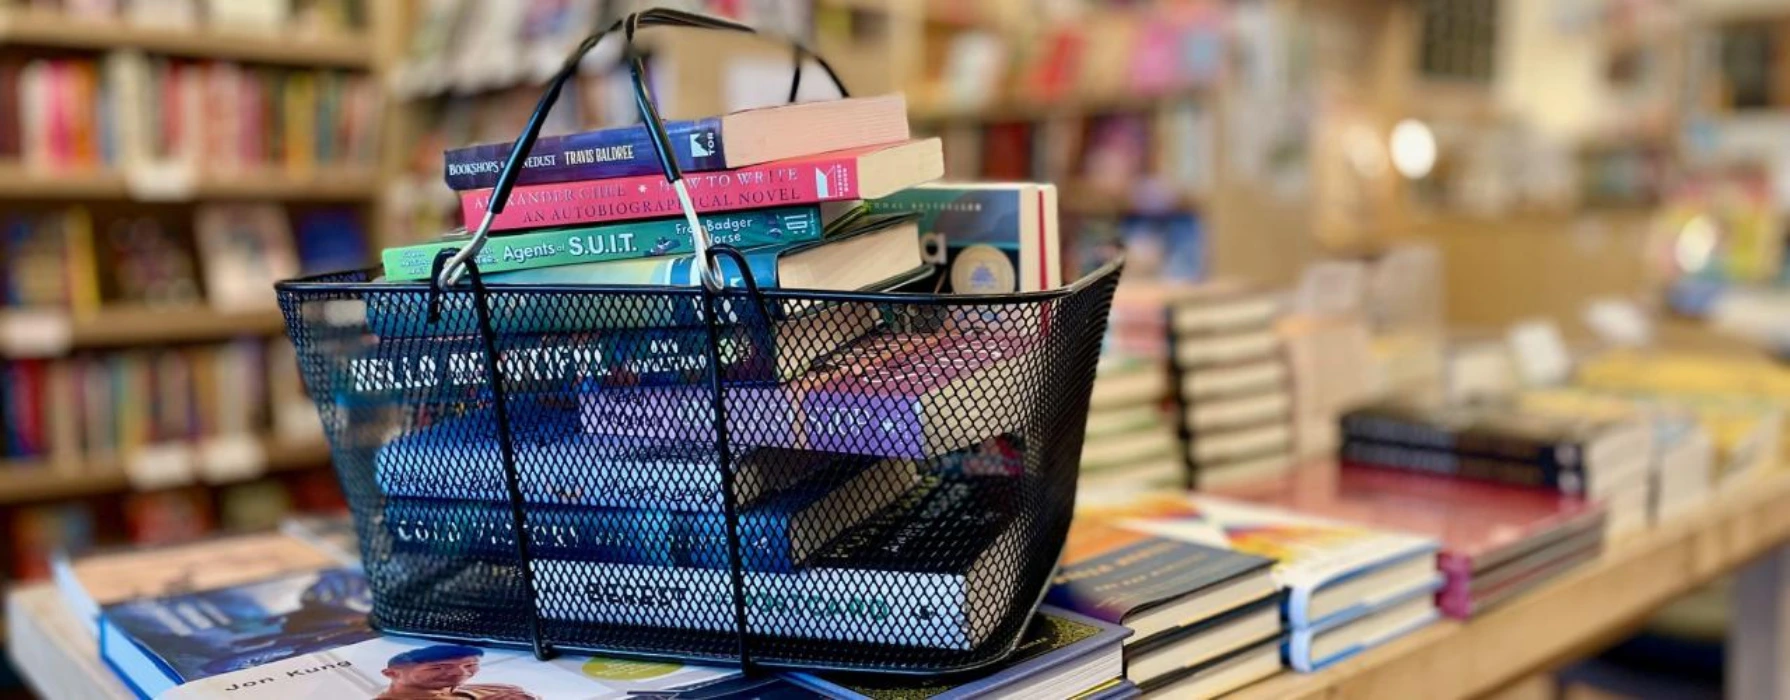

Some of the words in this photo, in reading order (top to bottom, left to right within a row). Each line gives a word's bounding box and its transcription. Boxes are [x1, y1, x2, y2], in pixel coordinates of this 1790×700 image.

[564, 148, 594, 165] TRAVIS
[596, 145, 635, 162] BALDREE
[706, 132, 716, 156] TOR
[449, 160, 498, 176] BOOKSHOPS
[522, 154, 556, 170] NEDUST
[706, 174, 731, 188] TO
[737, 168, 799, 183] WRITE
[523, 210, 546, 224] AN
[739, 187, 801, 205] NOVEL
[675, 222, 695, 236] Fro
[706, 217, 754, 232] Badger
[503, 242, 555, 263] Agents
[568, 232, 638, 256] S.U.I.T.
[225, 676, 274, 692] Jon
[286, 660, 352, 678] Kung
